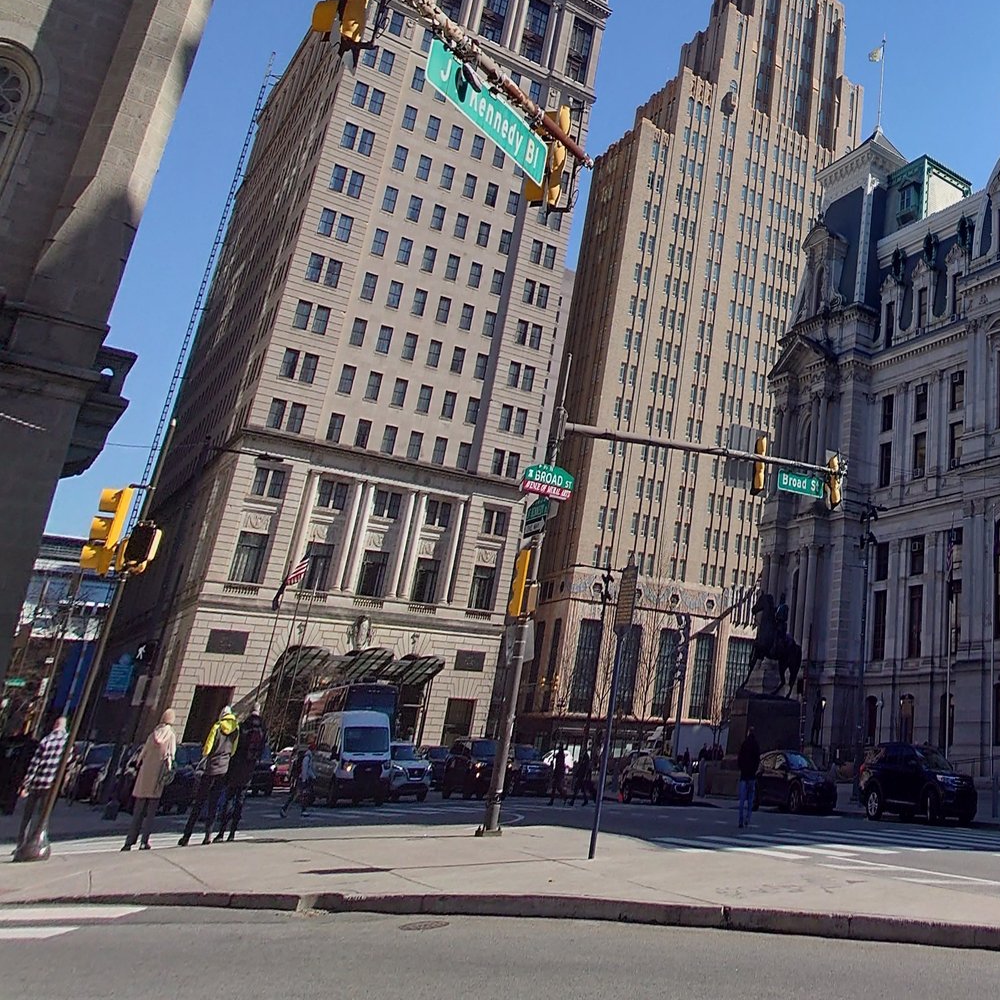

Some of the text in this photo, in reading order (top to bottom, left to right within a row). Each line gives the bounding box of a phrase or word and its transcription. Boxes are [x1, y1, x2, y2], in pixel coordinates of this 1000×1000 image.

[440, 58, 452, 82] J
[534, 470, 563, 487] BROAD
[564, 480, 573, 489] ST
[782, 473, 820, 492] Broad St
